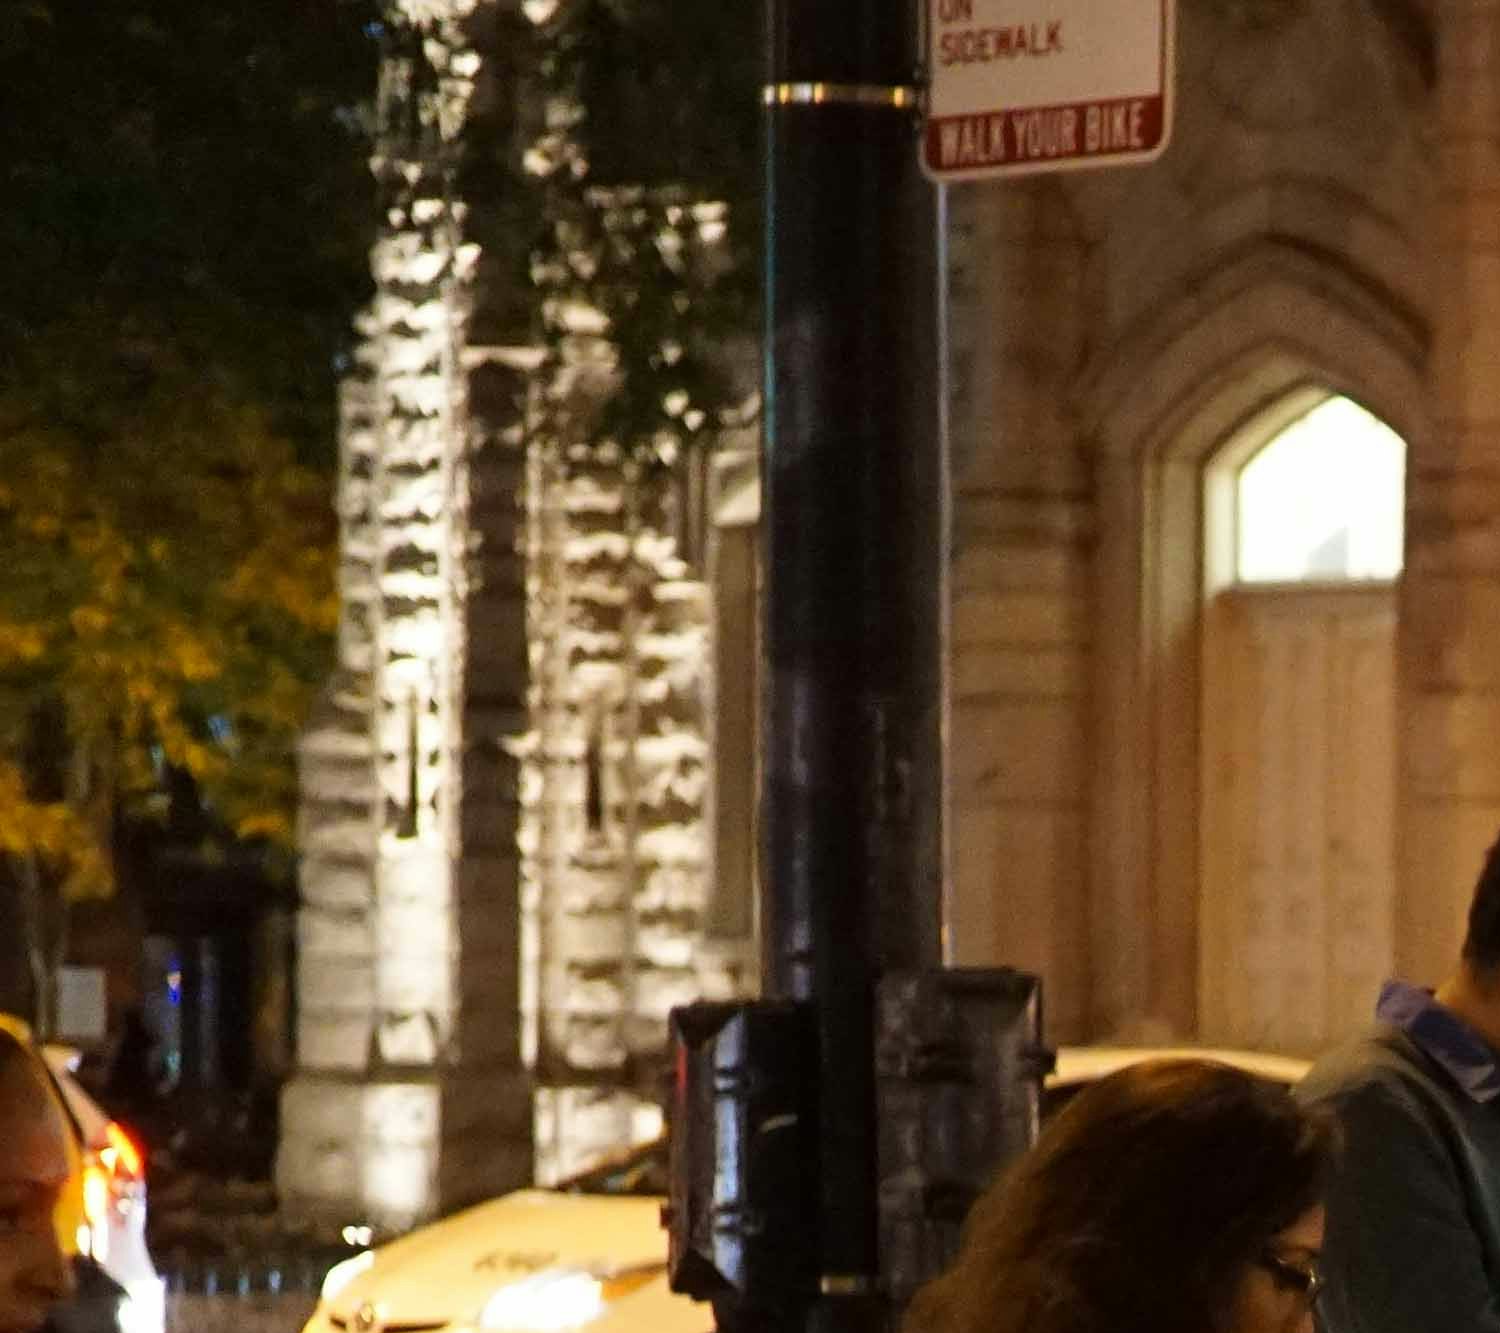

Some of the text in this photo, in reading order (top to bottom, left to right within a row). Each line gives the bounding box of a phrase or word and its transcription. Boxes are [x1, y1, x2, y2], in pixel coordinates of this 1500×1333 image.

[941, 22, 1063, 65] SIDEWALK
[940, 102, 1144, 165] WALK YOUR BIKE
